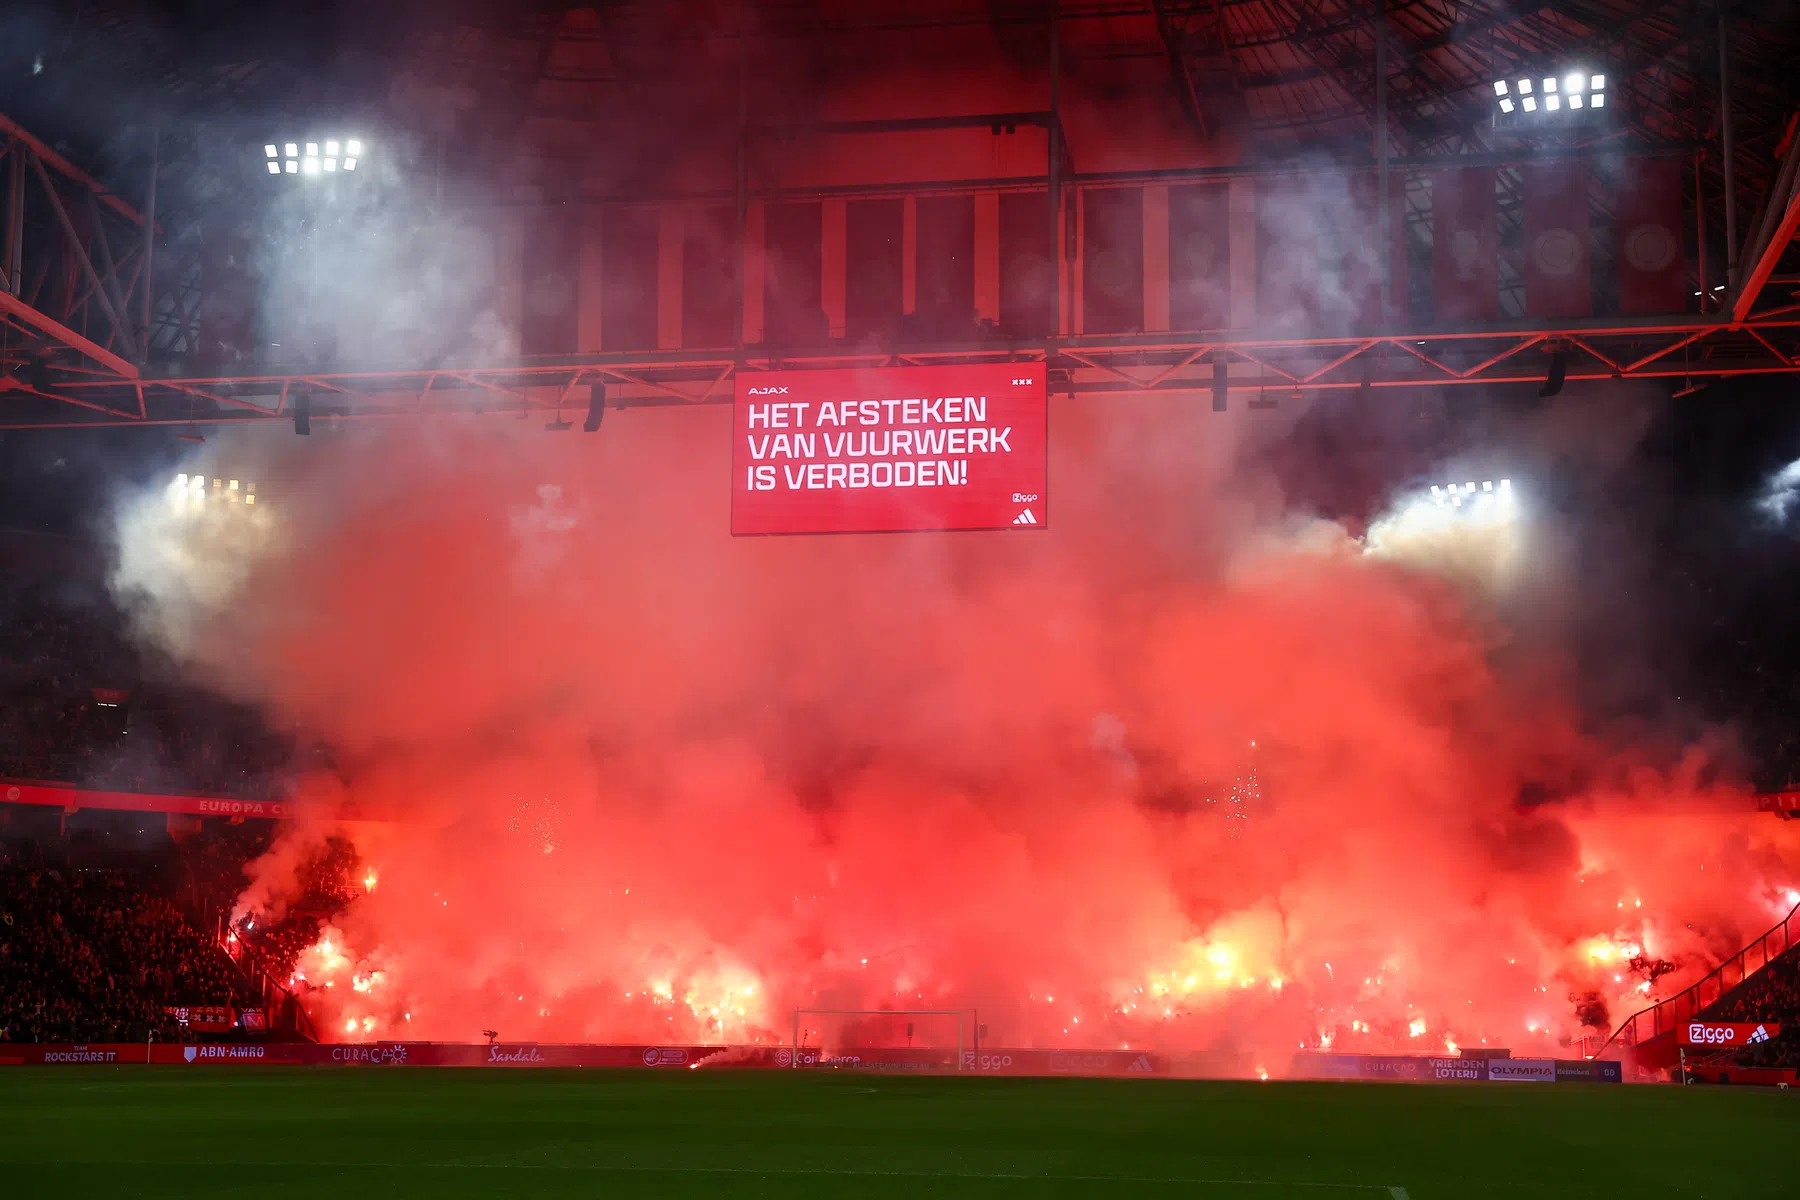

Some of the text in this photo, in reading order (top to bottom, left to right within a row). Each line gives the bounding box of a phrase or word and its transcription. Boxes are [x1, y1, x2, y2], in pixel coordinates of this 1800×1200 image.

[748, 387, 788, 395] AJAX
[749, 397, 986, 428] HET AFSTEKEN
[748, 427, 1012, 460] VAN VUURWERK
[748, 460, 968, 490] IS VERBODEN!
[200, 801, 263, 813] EUROPA
[45, 1052, 116, 1062] ROCKSTARS IT
[488, 1046, 544, 1062] Sandals
[796, 1052, 861, 1064] Coierce
[1428, 1059, 1485, 1069] VRIENDEN
[1436, 1068, 1478, 1079] LOTERIJ
[1491, 1066, 1552, 1076] OLYMPIA
